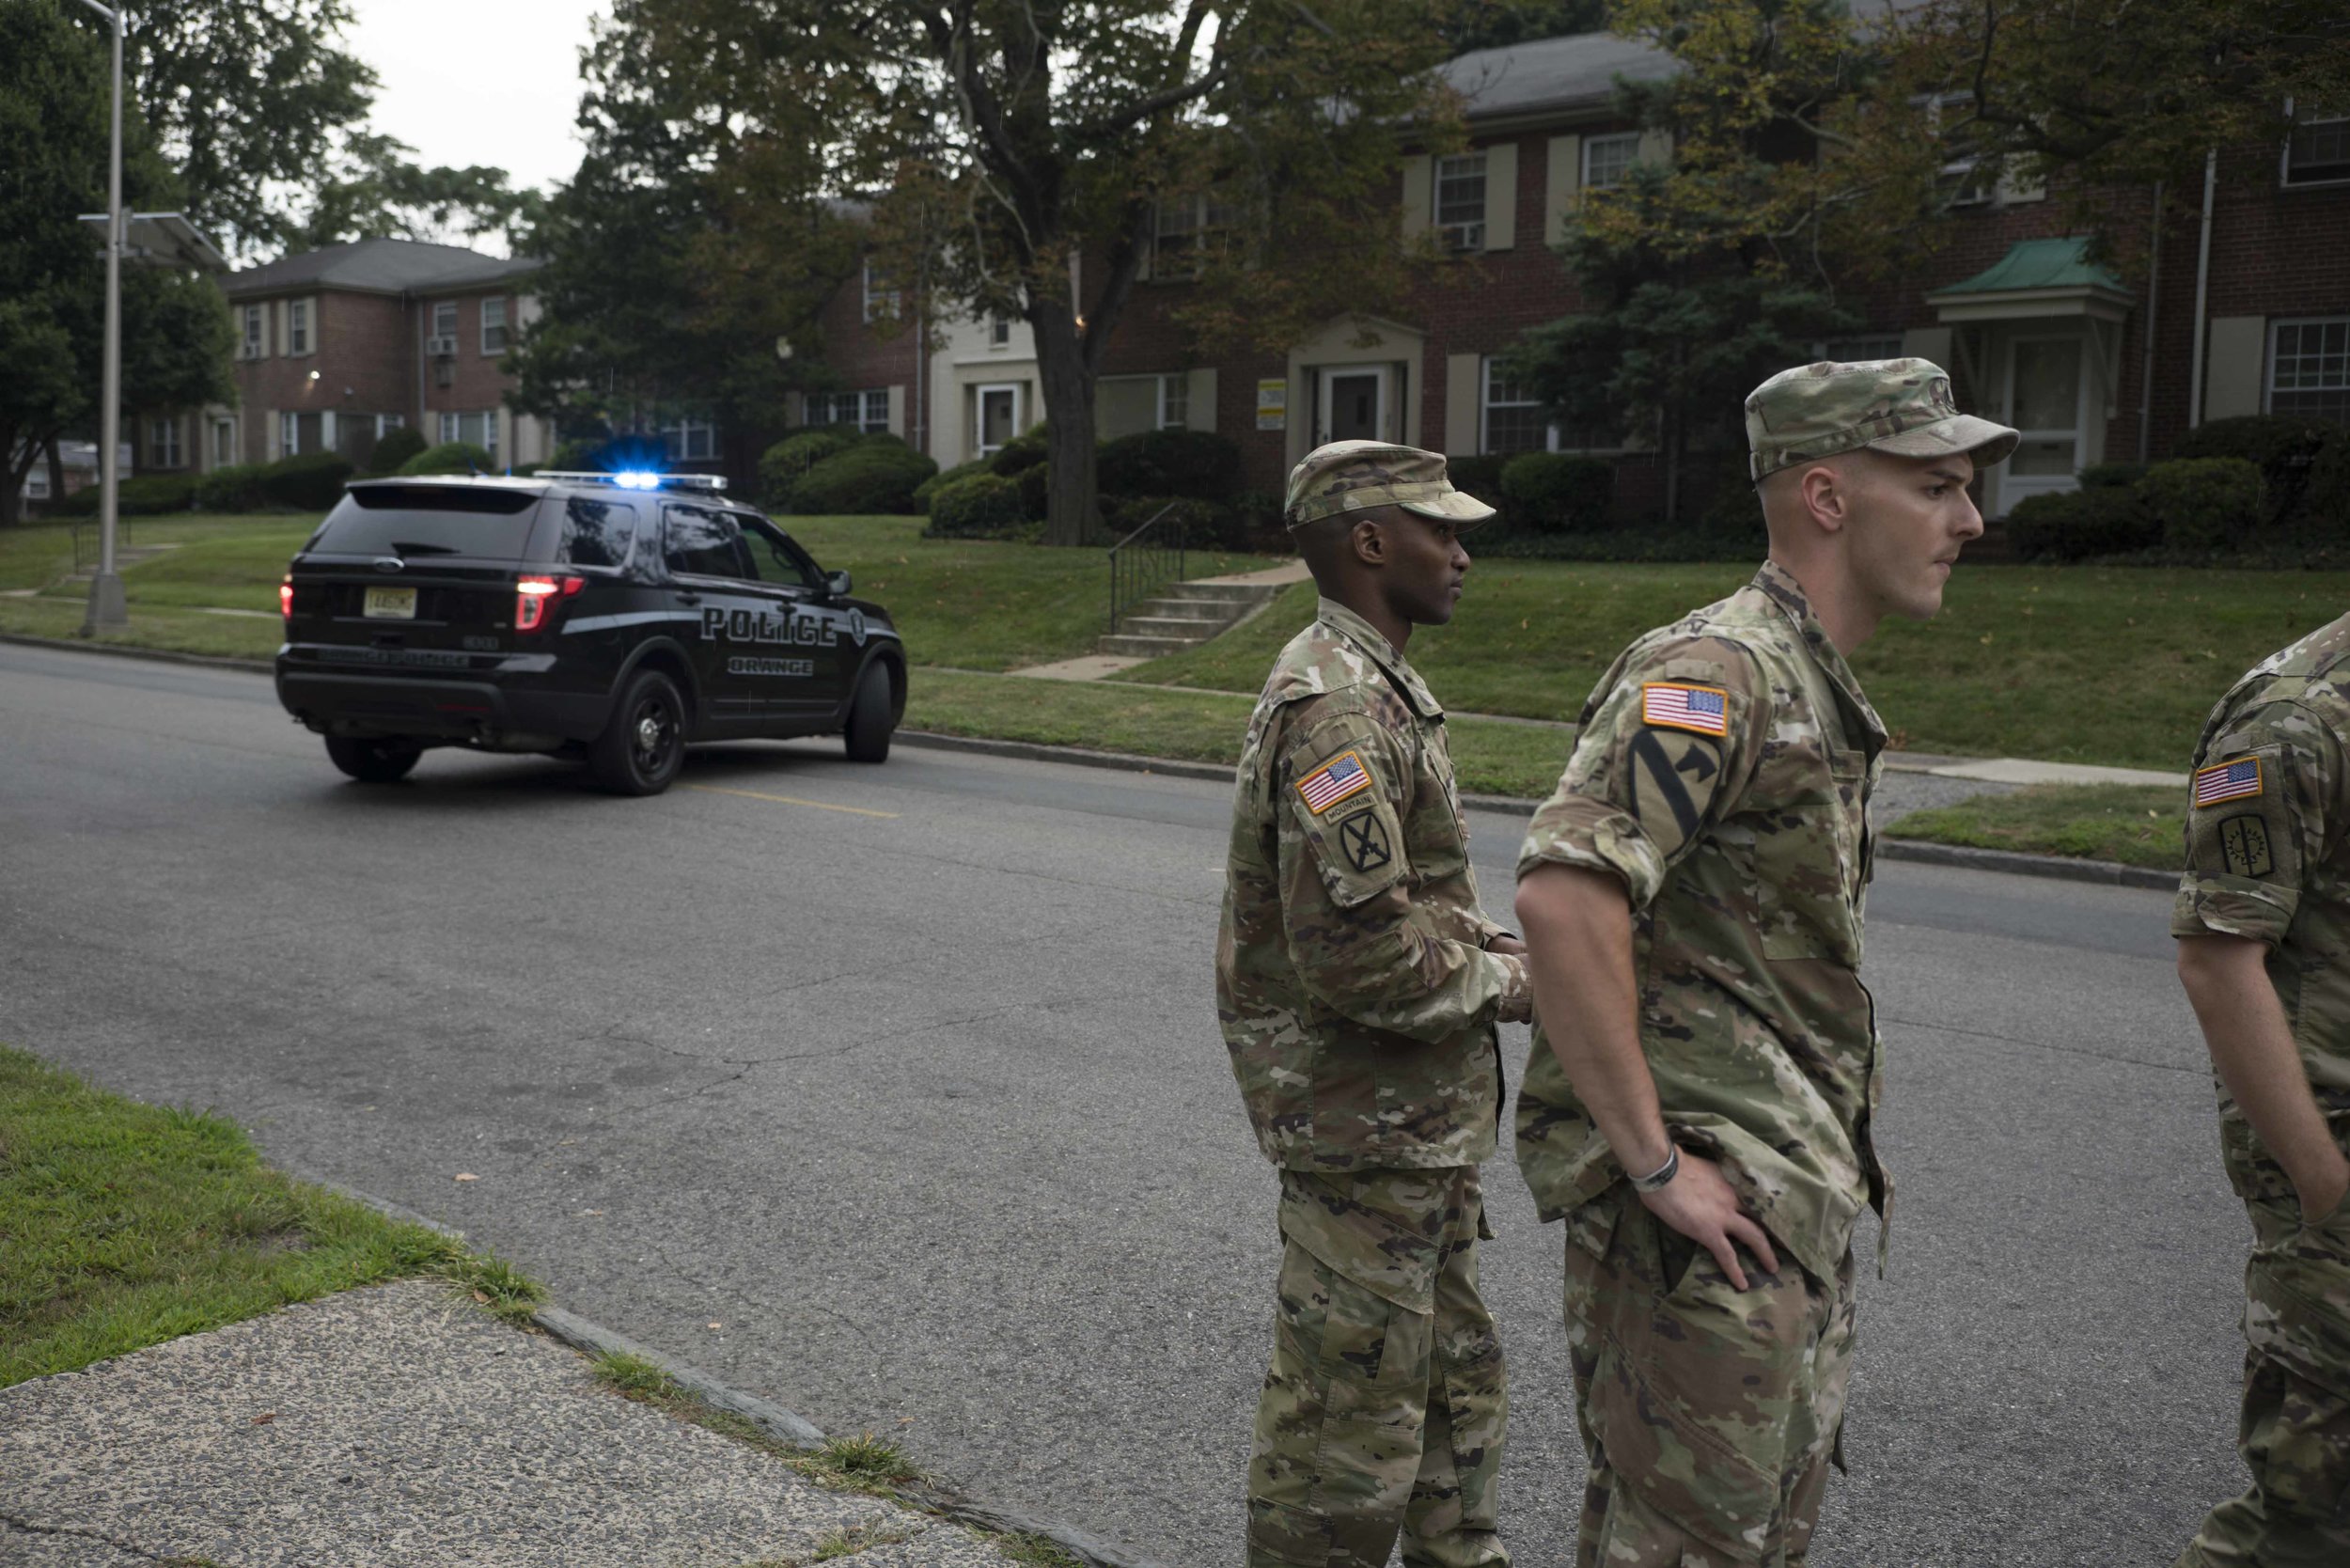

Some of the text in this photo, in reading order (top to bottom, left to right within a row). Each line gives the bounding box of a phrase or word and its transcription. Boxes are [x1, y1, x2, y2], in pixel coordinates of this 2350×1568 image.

[701, 605, 837, 646] POLICE
[728, 657, 813, 676] ORANGE
[1328, 795, 1371, 818] MOUNTAIN
